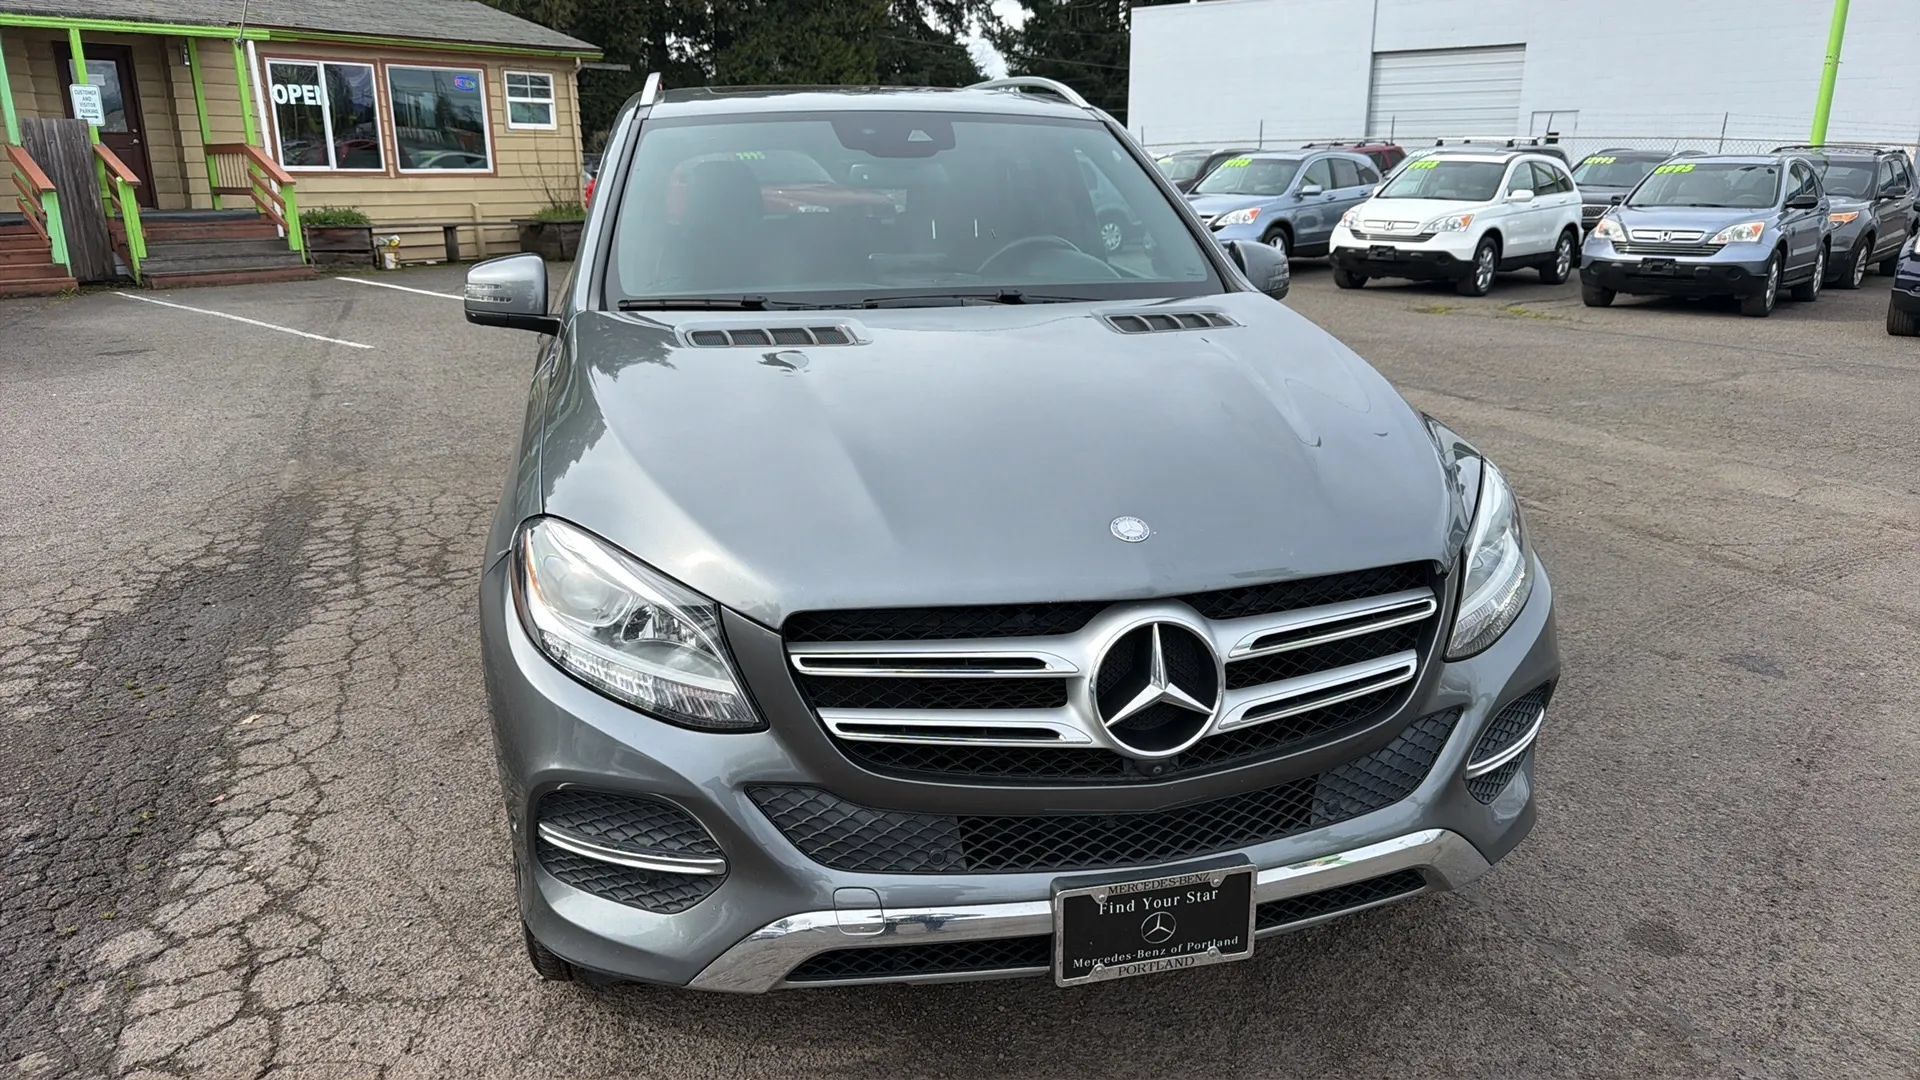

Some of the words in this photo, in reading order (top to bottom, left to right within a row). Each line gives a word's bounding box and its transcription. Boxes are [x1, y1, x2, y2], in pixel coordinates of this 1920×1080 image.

[1108, 873, 1210, 895] MERCEDES-BENZ
[1099, 899, 1135, 915] Find
[1143, 896, 1181, 911] Your
[1186, 889, 1219, 904] Star
[1073, 947, 1166, 969] Mercedes-Benz
[1170, 943, 1184, 954] of
[1187, 935, 1239, 952] Portland
[1118, 956, 1195, 977] PORTLAND
